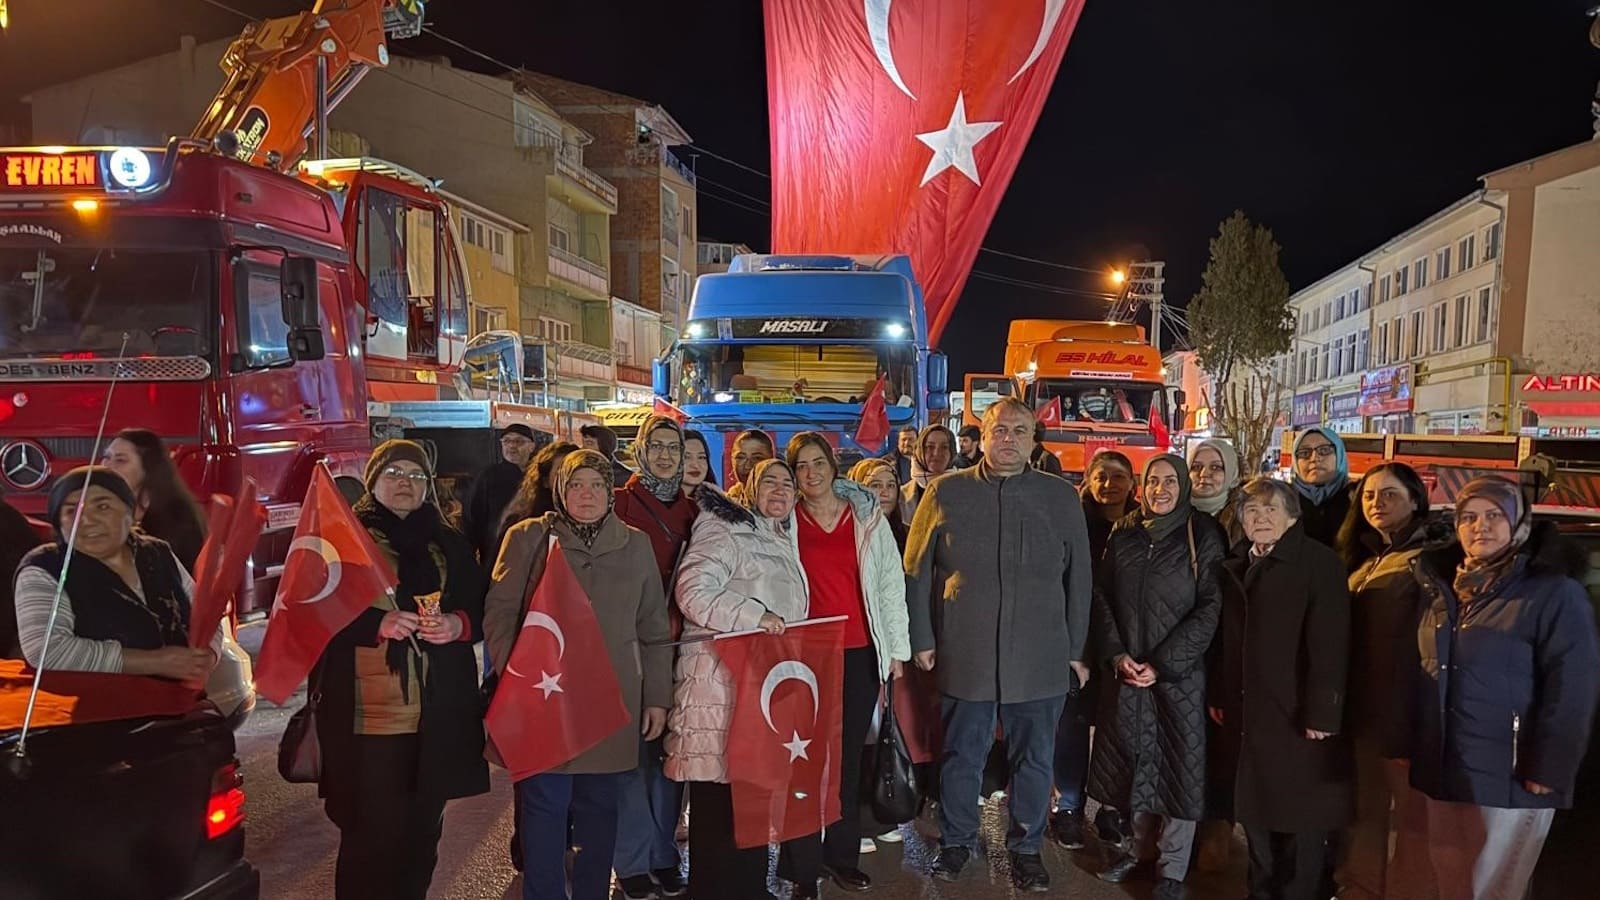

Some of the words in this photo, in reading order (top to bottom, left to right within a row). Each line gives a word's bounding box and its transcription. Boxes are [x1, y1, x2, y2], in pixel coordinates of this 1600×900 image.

[6, 155, 96, 186] EVREN
[760, 320, 829, 334] MASALI
[1056, 352, 1086, 363] ES
[1087, 350, 1148, 366] HİLAL
[1522, 374, 1600, 391] ALTIN
